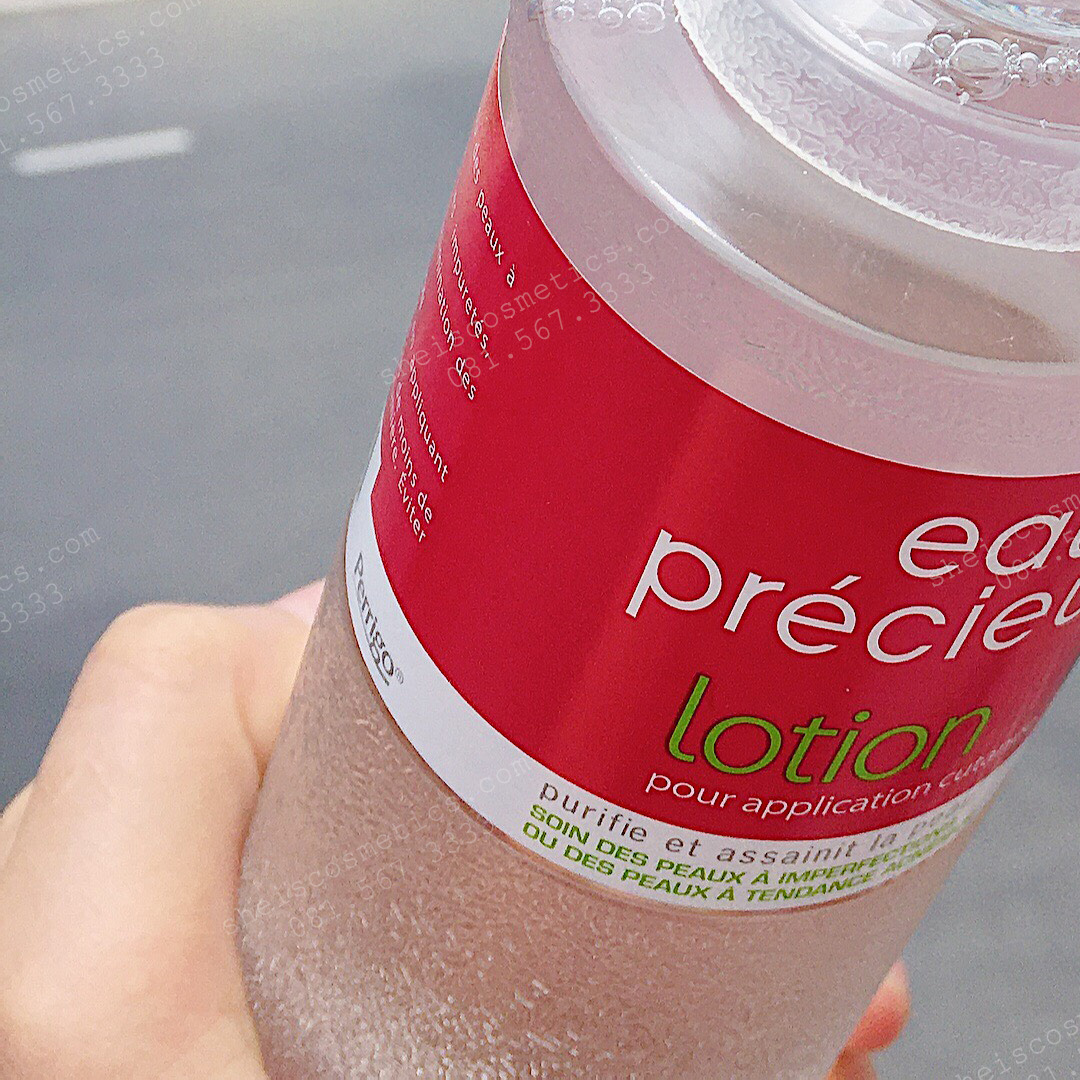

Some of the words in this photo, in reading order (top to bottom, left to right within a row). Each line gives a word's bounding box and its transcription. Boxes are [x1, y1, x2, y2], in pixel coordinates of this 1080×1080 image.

[474, 188, 505, 266] peaux
[505, 263, 517, 289] à
[450, 223, 492, 359] impuretés,
[409, 353, 449, 483] appliquant
[455, 356, 477, 401] des
[397, 415, 419, 488] moins
[417, 491, 434, 524] de
[398, 471, 427, 544] Éviter
[665, 673, 993, 784] lotion
[539, 783, 648, 843] purifie
[665, 837, 702, 858] et
[717, 840, 857, 865] assainit
[869, 832, 897, 853] la
[645, 772, 737, 808] pour
[742, 782, 933, 821] application
[522, 821, 558, 850] OU
[563, 844, 615, 876] DES
[620, 869, 711, 900] PEAUX
[716, 885, 735, 902] À
[747, 872, 875, 902] TENDANCE
[530, 803, 591, 845] SOIN
[595, 838, 649, 867] DES
[655, 858, 746, 885] PEAUX
[750, 869, 770, 885] À
